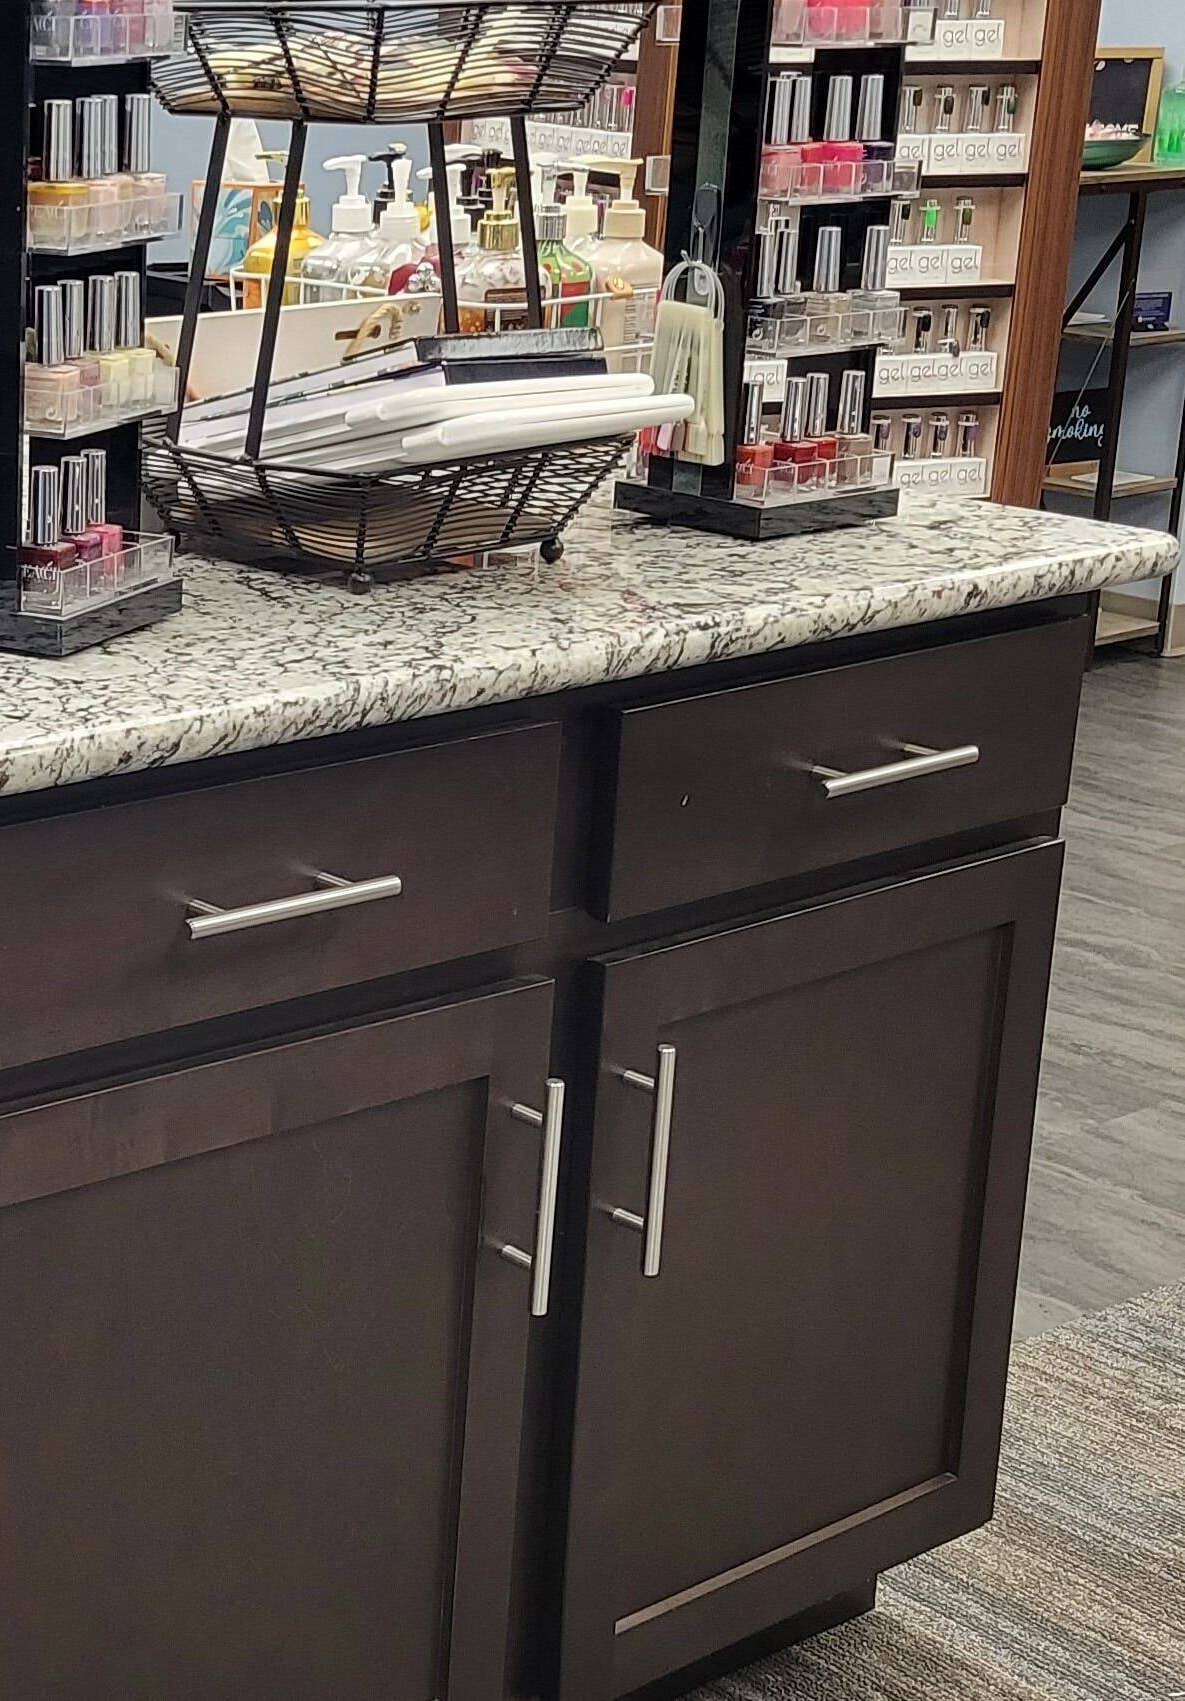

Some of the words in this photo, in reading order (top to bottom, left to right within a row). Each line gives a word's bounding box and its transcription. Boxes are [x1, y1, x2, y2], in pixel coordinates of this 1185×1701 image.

[943, 23, 969, 48] gel
[974, 22, 1001, 47] gel
[933, 138, 960, 161] gel
[965, 137, 991, 161] gel
[996, 137, 1022, 161] gel
[887, 250, 913, 275] gel
[918, 250, 944, 273] gel
[950, 249, 978, 274] gel
[878, 361, 905, 385] gel
[910, 358, 937, 382] gel
[937, 358, 964, 381] gel
[968, 357, 994, 379] gel
[1071, 405, 1092, 419] no
[900, 464, 925, 487] gel
[928, 463, 954, 486] gel
[957, 461, 982, 482] gel
